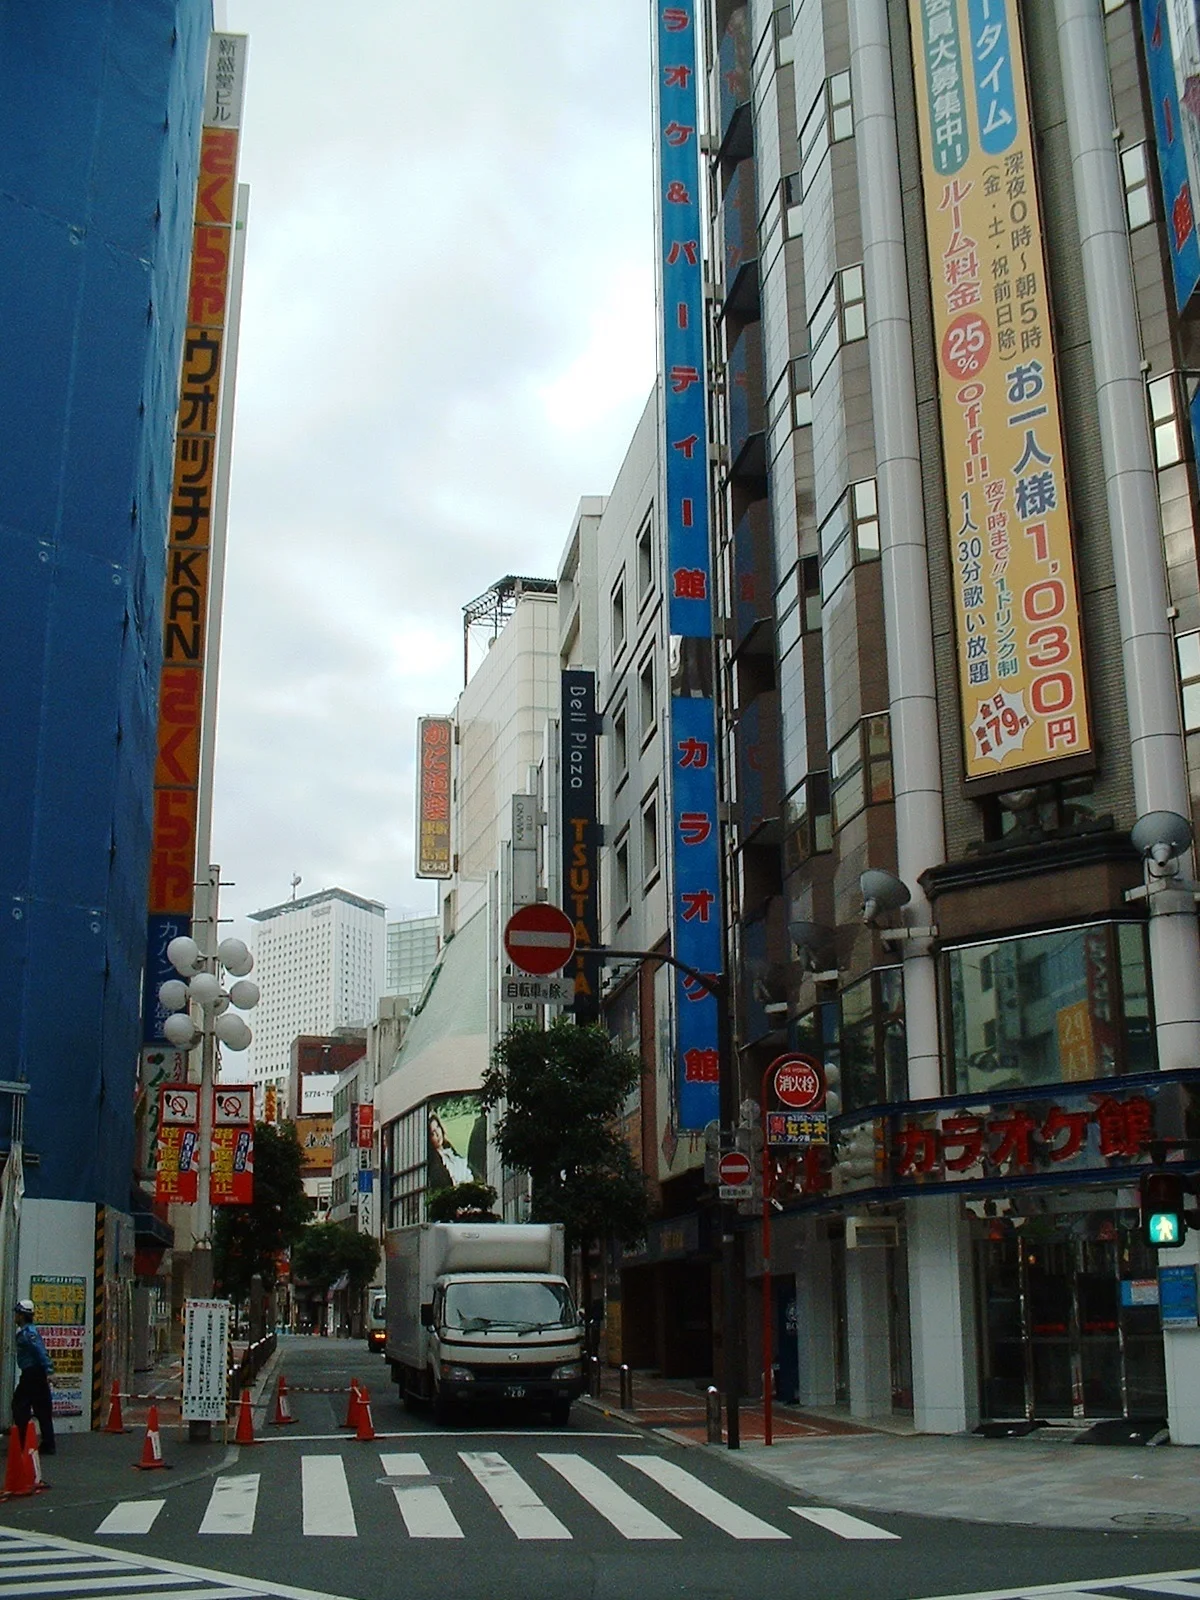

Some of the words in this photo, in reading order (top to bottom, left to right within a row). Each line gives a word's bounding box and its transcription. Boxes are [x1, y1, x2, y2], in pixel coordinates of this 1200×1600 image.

[191, 131, 238, 323] さくらや
[937, 178, 982, 314] ルーム料金
[164, 551, 202, 660] KAN
[153, 669, 199, 910] さくらや
[570, 733, 587, 789] Plaza
[778, 1075, 815, 1093] 消火栓
[786, 1120, 827, 1136] セキネ
[893, 1094, 1154, 1176] カラオケ館
